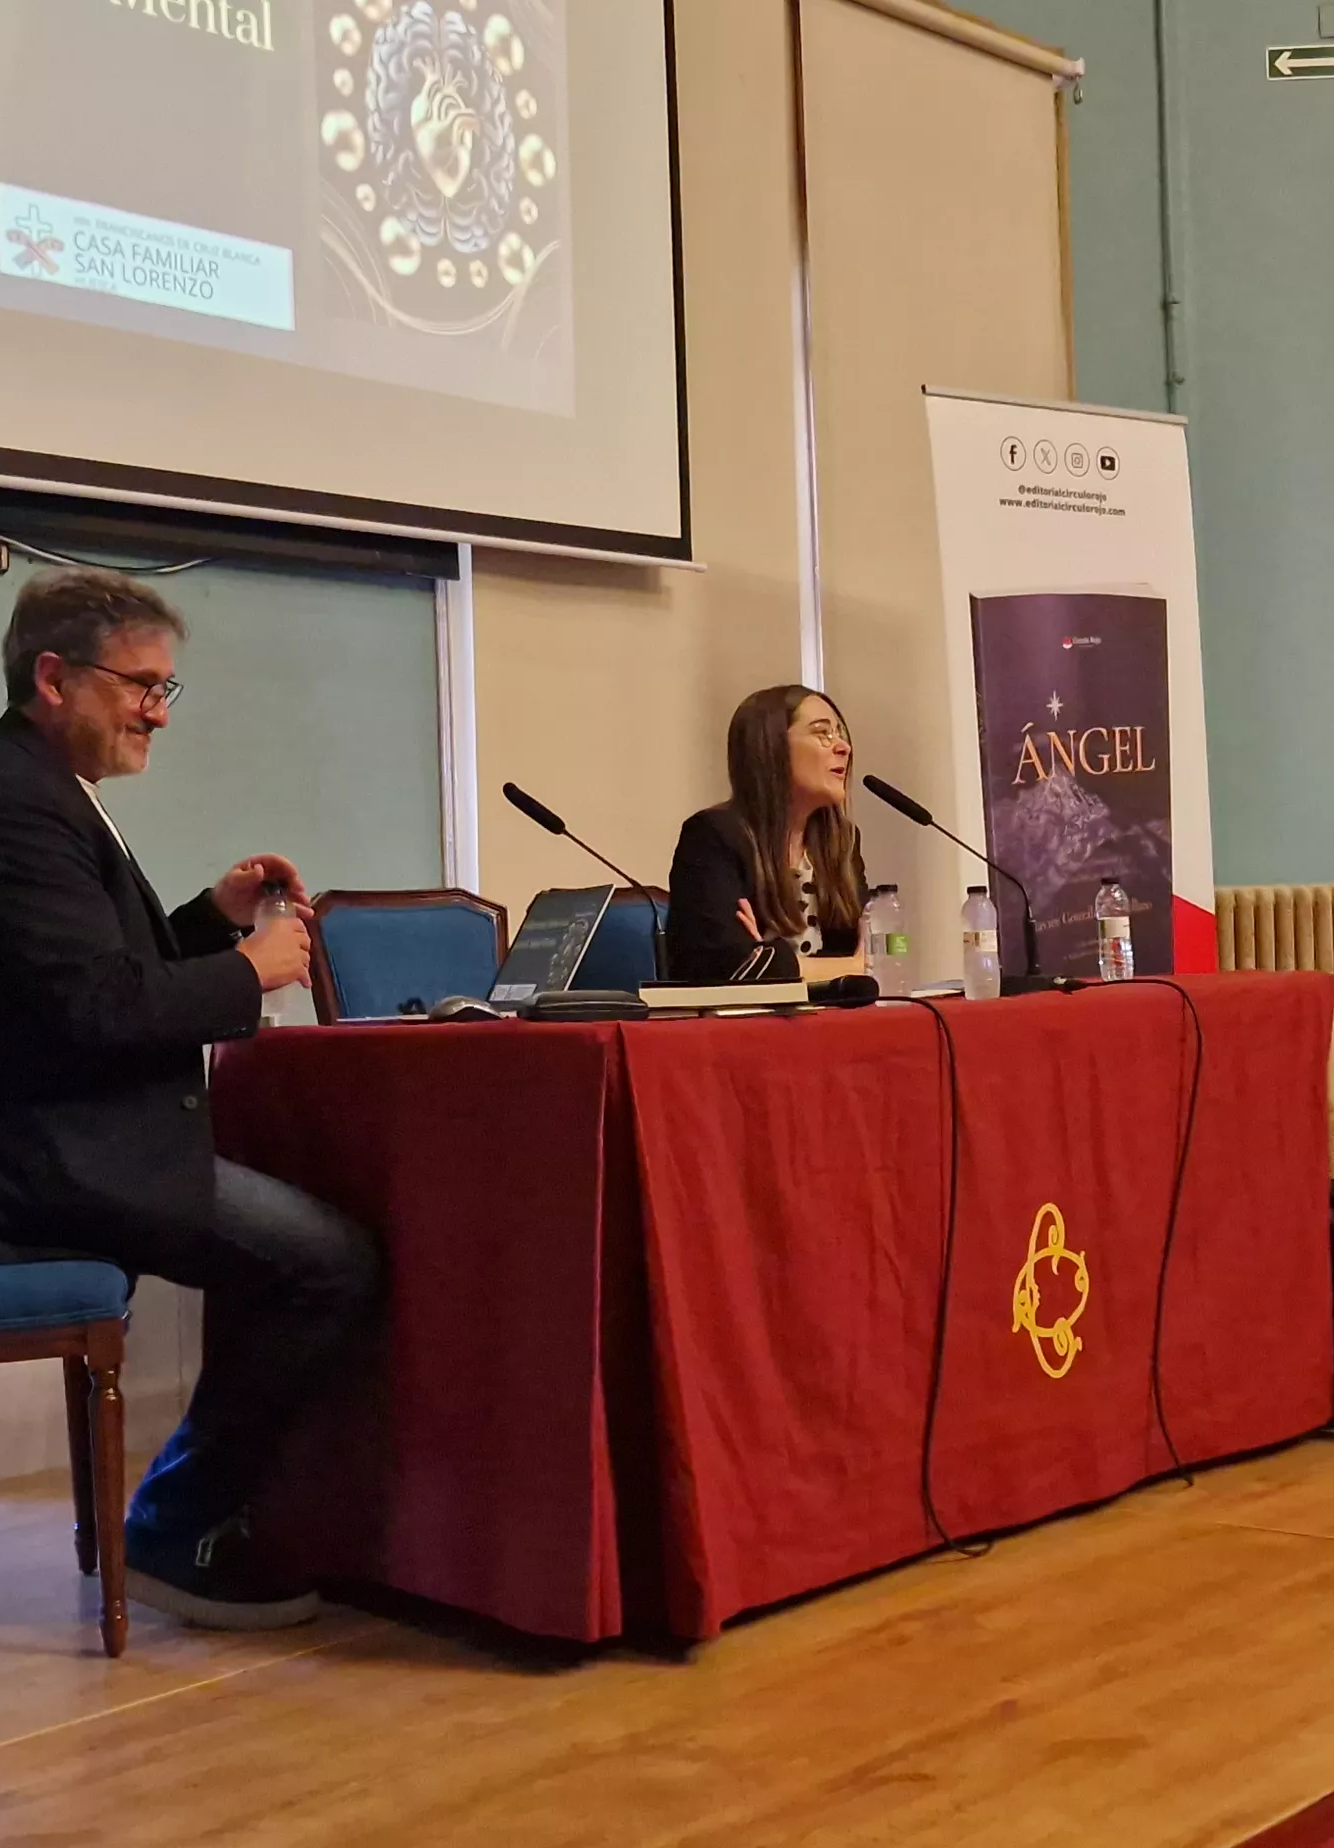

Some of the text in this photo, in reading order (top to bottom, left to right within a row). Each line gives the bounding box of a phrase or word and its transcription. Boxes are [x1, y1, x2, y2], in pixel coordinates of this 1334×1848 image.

[73, 230, 221, 279] CASA FAMILIAR
[74, 255, 115, 279] SAN
[122, 263, 214, 300] LORENZO
[1011, 722, 1156, 785] ÁNGEL
